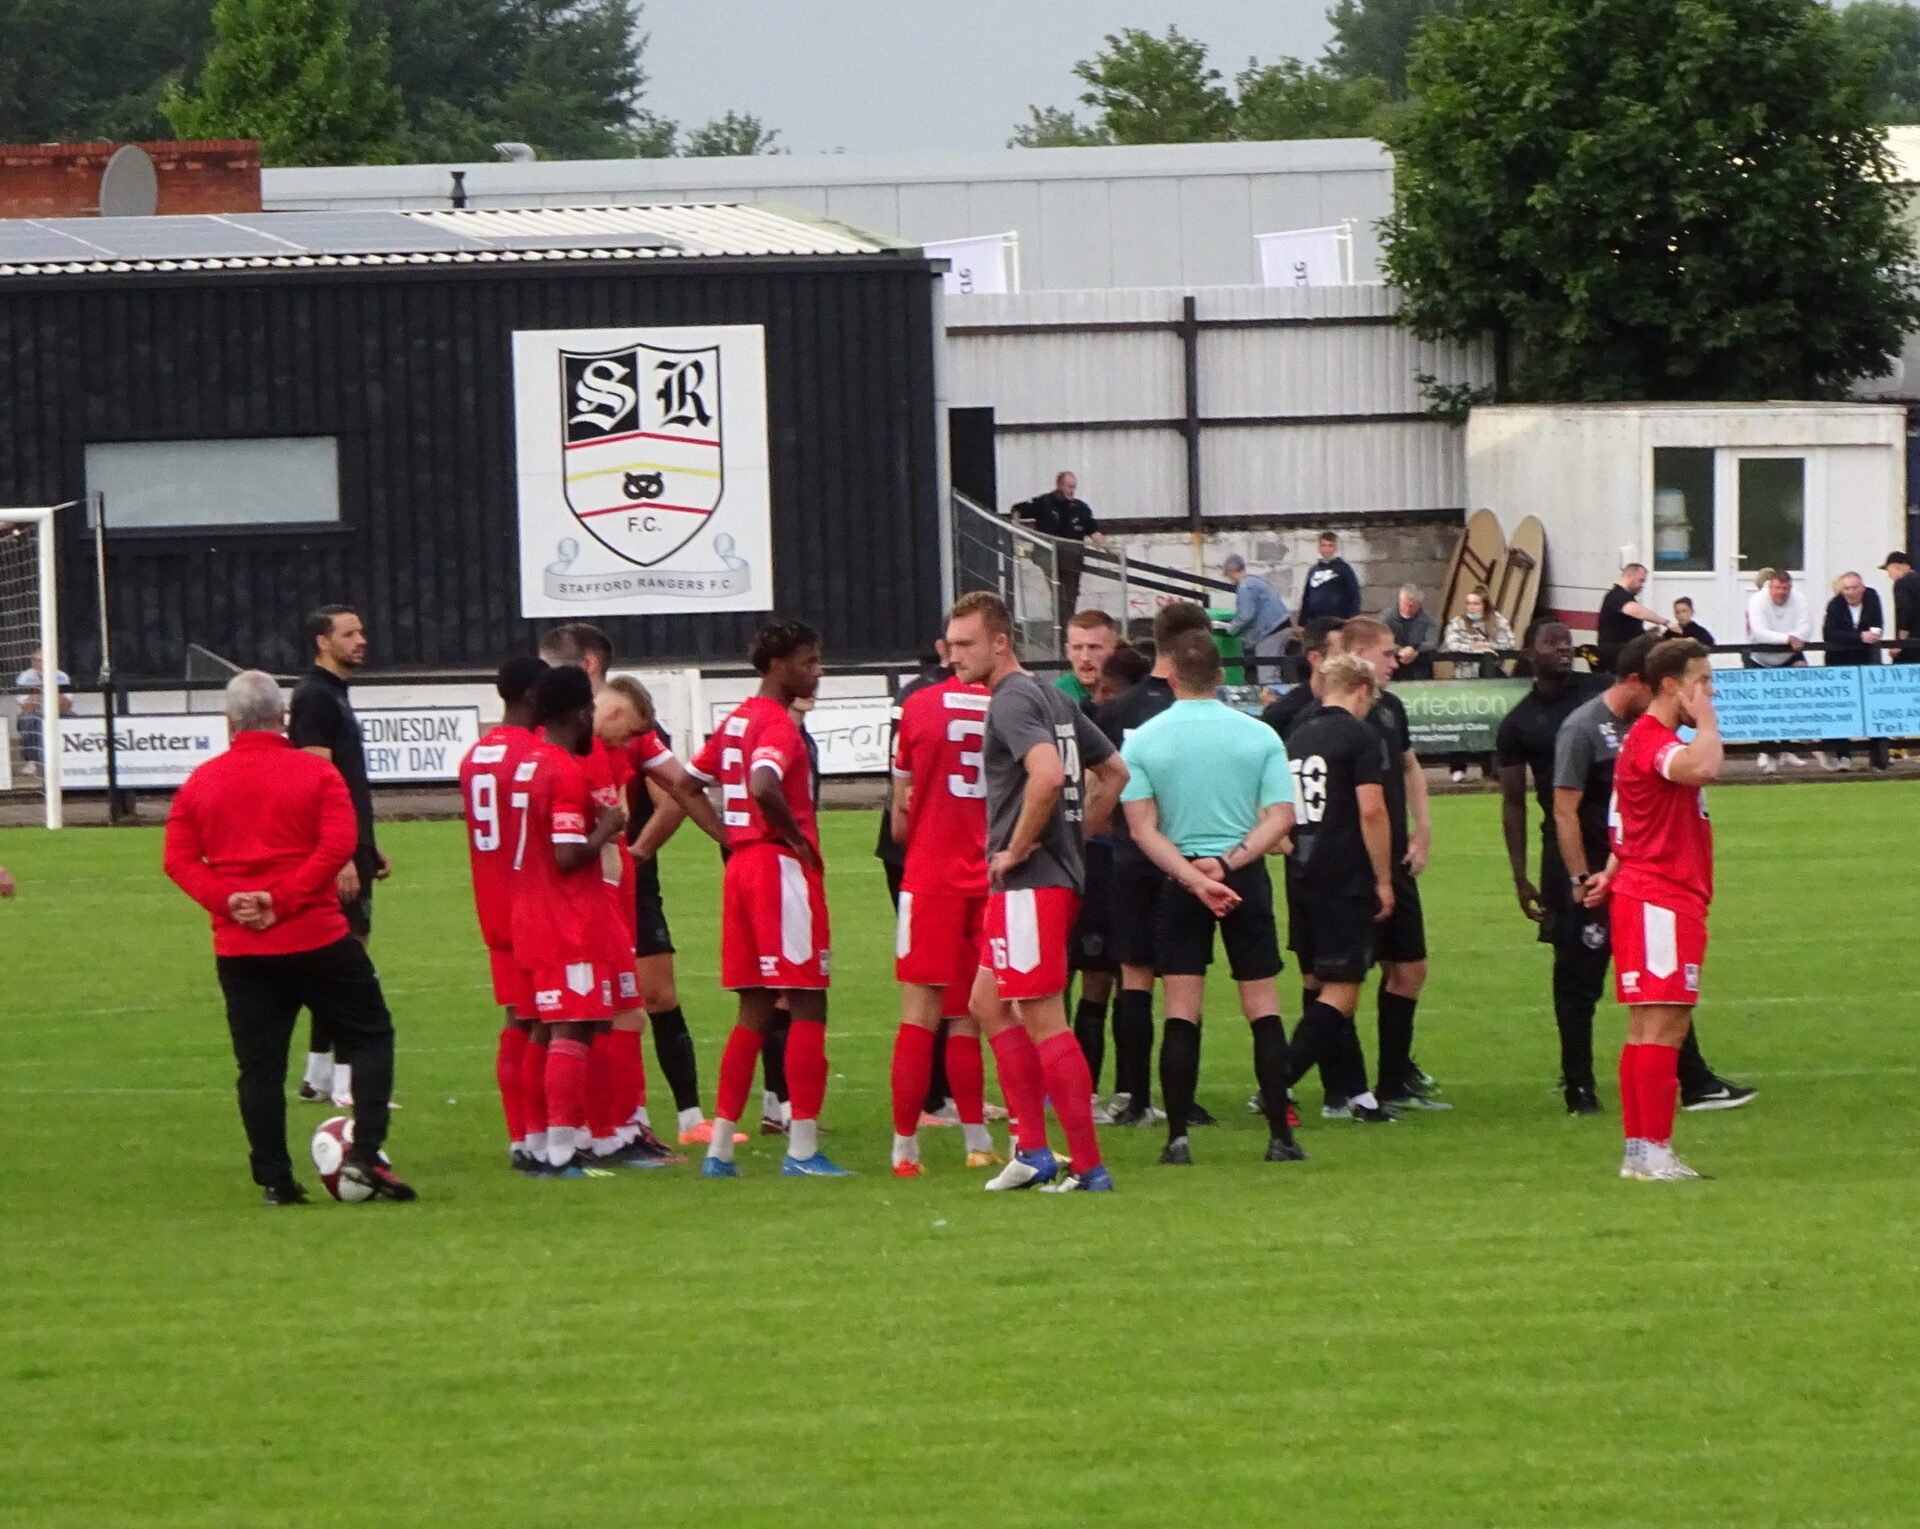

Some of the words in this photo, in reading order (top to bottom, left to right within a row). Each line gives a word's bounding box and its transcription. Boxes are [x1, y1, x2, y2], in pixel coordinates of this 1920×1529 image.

[569, 359, 637, 431] S
[653, 358, 713, 428] R
[627, 516, 663, 533] F.C.
[559, 579, 632, 593] STAFFORD
[638, 577, 704, 590] RANGERS
[1762, 669, 1833, 683] PLUMBING
[1402, 692, 1507, 716] erfection
[1714, 687, 1758, 700] ATING
[1763, 685, 1850, 700] MERCHANTS
[361, 716, 462, 742] EDNESDAY,
[367, 748, 400, 772] ERY
[408, 746, 446, 771] DAY
[947, 719, 987, 798] 3
[722, 747, 751, 826] 2
[471, 773, 500, 851] 9
